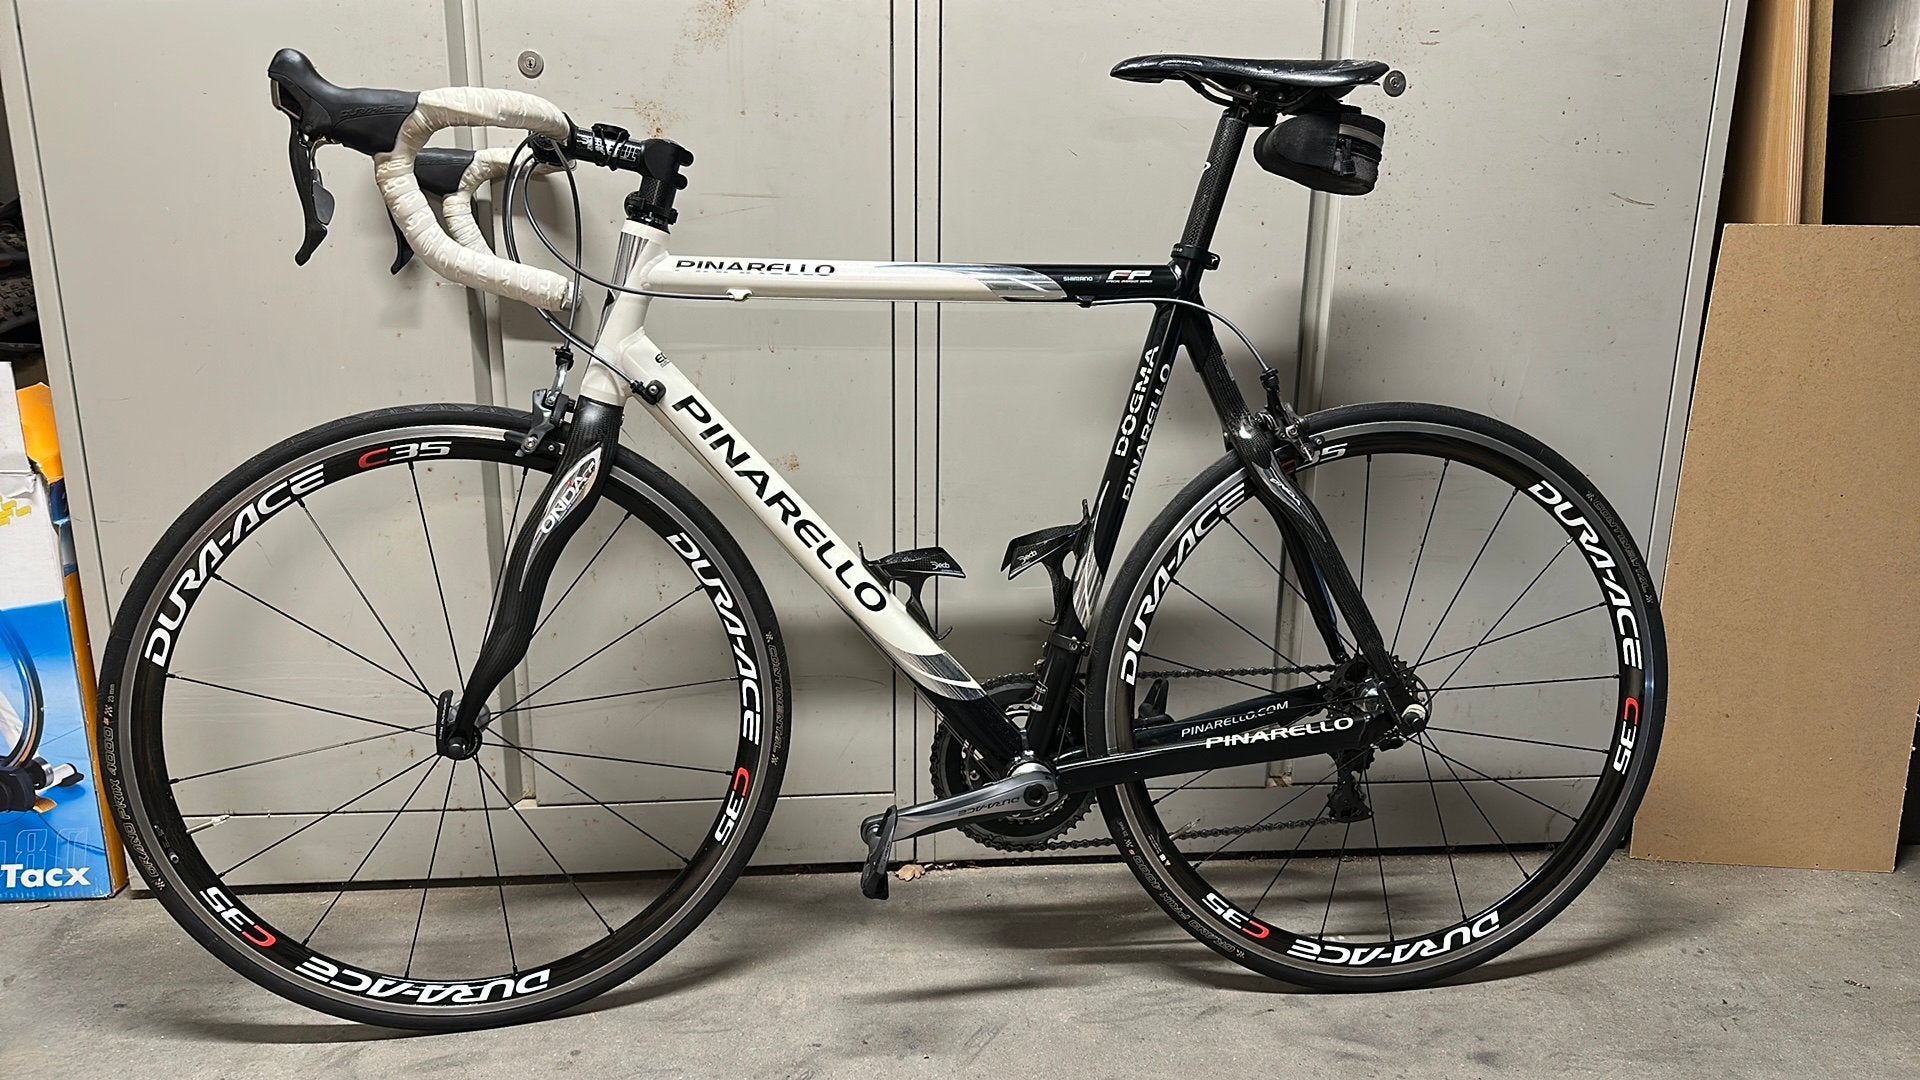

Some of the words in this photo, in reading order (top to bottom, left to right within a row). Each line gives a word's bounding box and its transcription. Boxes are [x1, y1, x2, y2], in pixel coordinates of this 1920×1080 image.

[675, 259, 835, 277] PINARELLO
[1115, 345, 1160, 457] DOGMA
[1122, 363, 1171, 502] PINARELLO
[672, 395, 887, 613] PINARELLO
[144, 463, 324, 668] DURA-ACE
[358, 441, 452, 470] C35
[1120, 482, 1245, 686] DURA-ACE
[1528, 479, 1643, 671] DURA-ACE
[1612, 695, 1641, 775] C35
[665, 532, 760, 745] DURA-ACE
[714, 766, 750, 846] C35
[1181, 700, 1290, 738] PINARELLO.COM
[1205, 716, 1355, 750] PINARELLO
[103, 726, 118, 777] 4000
[110, 778, 131, 820] PRIX
[1, 863, 91, 889] Tacx
[201, 886, 276, 948] C35
[1201, 892, 1270, 941] C35
[1286, 909, 1501, 966] DURA-ACE
[295, 956, 551, 1005] DURA-ACE
